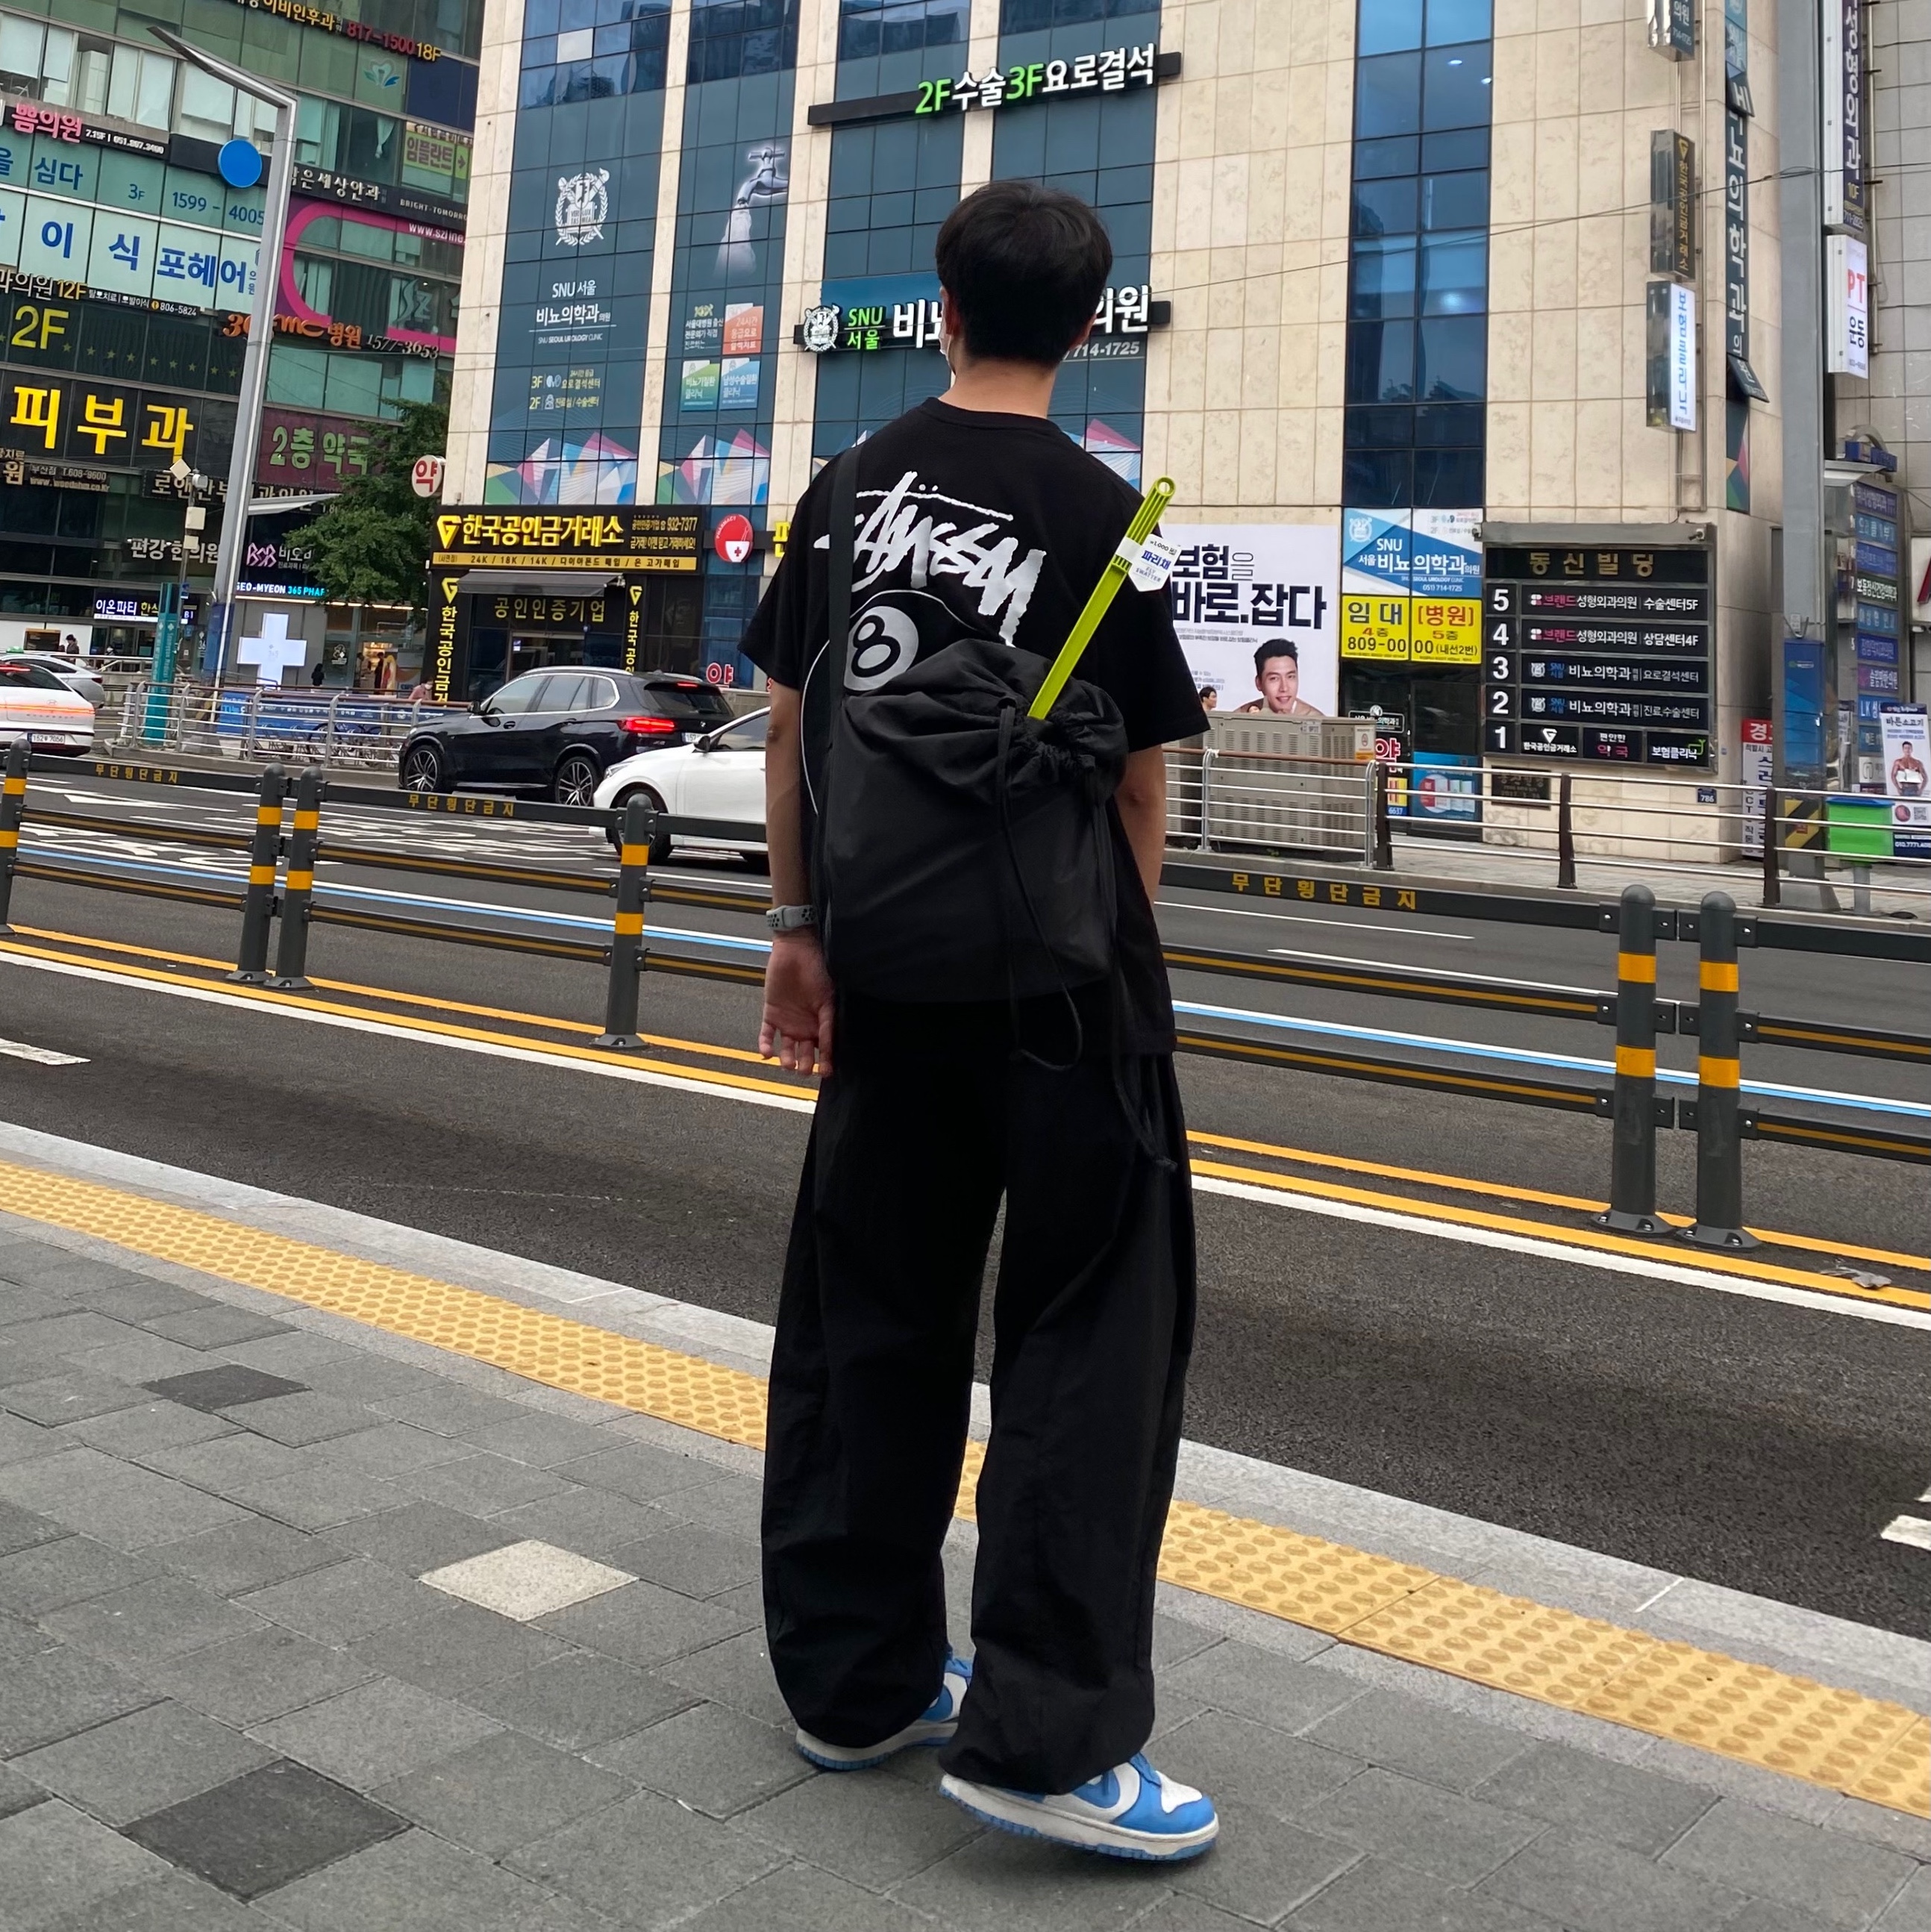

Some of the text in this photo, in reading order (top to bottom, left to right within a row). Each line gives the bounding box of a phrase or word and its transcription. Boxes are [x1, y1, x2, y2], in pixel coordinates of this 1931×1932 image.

[346, 21, 416, 55] 817-1500
[416, 43, 442, 63] 18F
[1042, 43, 1156, 93] 요로결석
[11, 102, 84, 143] 쁨의원
[407, 137, 454, 171] 임플란트
[34, 157, 84, 190] 심다
[128, 184, 145, 201] 3F
[157, 247, 247, 294] 포헤어
[57, 279, 88, 301] 12F
[160, 301, 198, 316] 806-5824
[551, 279, 597, 298] SNU 서울
[1847, 268, 1866, 304] PT
[11, 305, 70, 350] 2F
[536, 303, 600, 327] 비뇨의학과
[847, 306, 885, 328] SNU
[366, 334, 439, 359] 1577-3653
[846, 329, 881, 351] 서울
[531, 375, 543, 390] 3F
[529, 396, 542, 410] 2F
[10, 385, 194, 464] 피부과
[269, 426, 315, 469] 2층
[416, 460, 438, 493] 약
[462, 513, 625, 548] 한국공인금거래소
[1376, 538, 1403, 551] SNU
[471, 555, 488, 564] 24K
[501, 556, 518, 565] 18K
[530, 557, 548, 566] 14K
[560, 557, 601, 566] 다이아몬드
[1141, 549, 1172, 570] 파리채
[1358, 554, 1377, 566] 서울
[1530, 551, 1654, 578] 동신빌딩
[287, 586, 302, 596] 365
[1493, 589, 1509, 611] 5
[96, 599, 137, 616] 이온파티
[494, 597, 606, 622] 공인인증기업
[1493, 623, 1509, 645] 4
[1492, 656, 1509, 680] 3
[1568, 664, 1632, 681] 비뇨의학과
[1643, 669, 1699, 683] 요로결석센터
[1492, 691, 1509, 714] 2
[1568, 699, 1632, 717] 비뇨의학과
[1495, 726, 1577, 754] 1 한국공인금거래소
[1600, 732, 1627, 743] 편안한
[1597, 744, 1629, 758] 약국
[1651, 745, 1697, 760] 보험클리닉
[95, 763, 178, 784] 무단횡단금지
[408, 794, 515, 817] 무단횡단금지
[1231, 872, 1416, 910] 무단횡단금지
